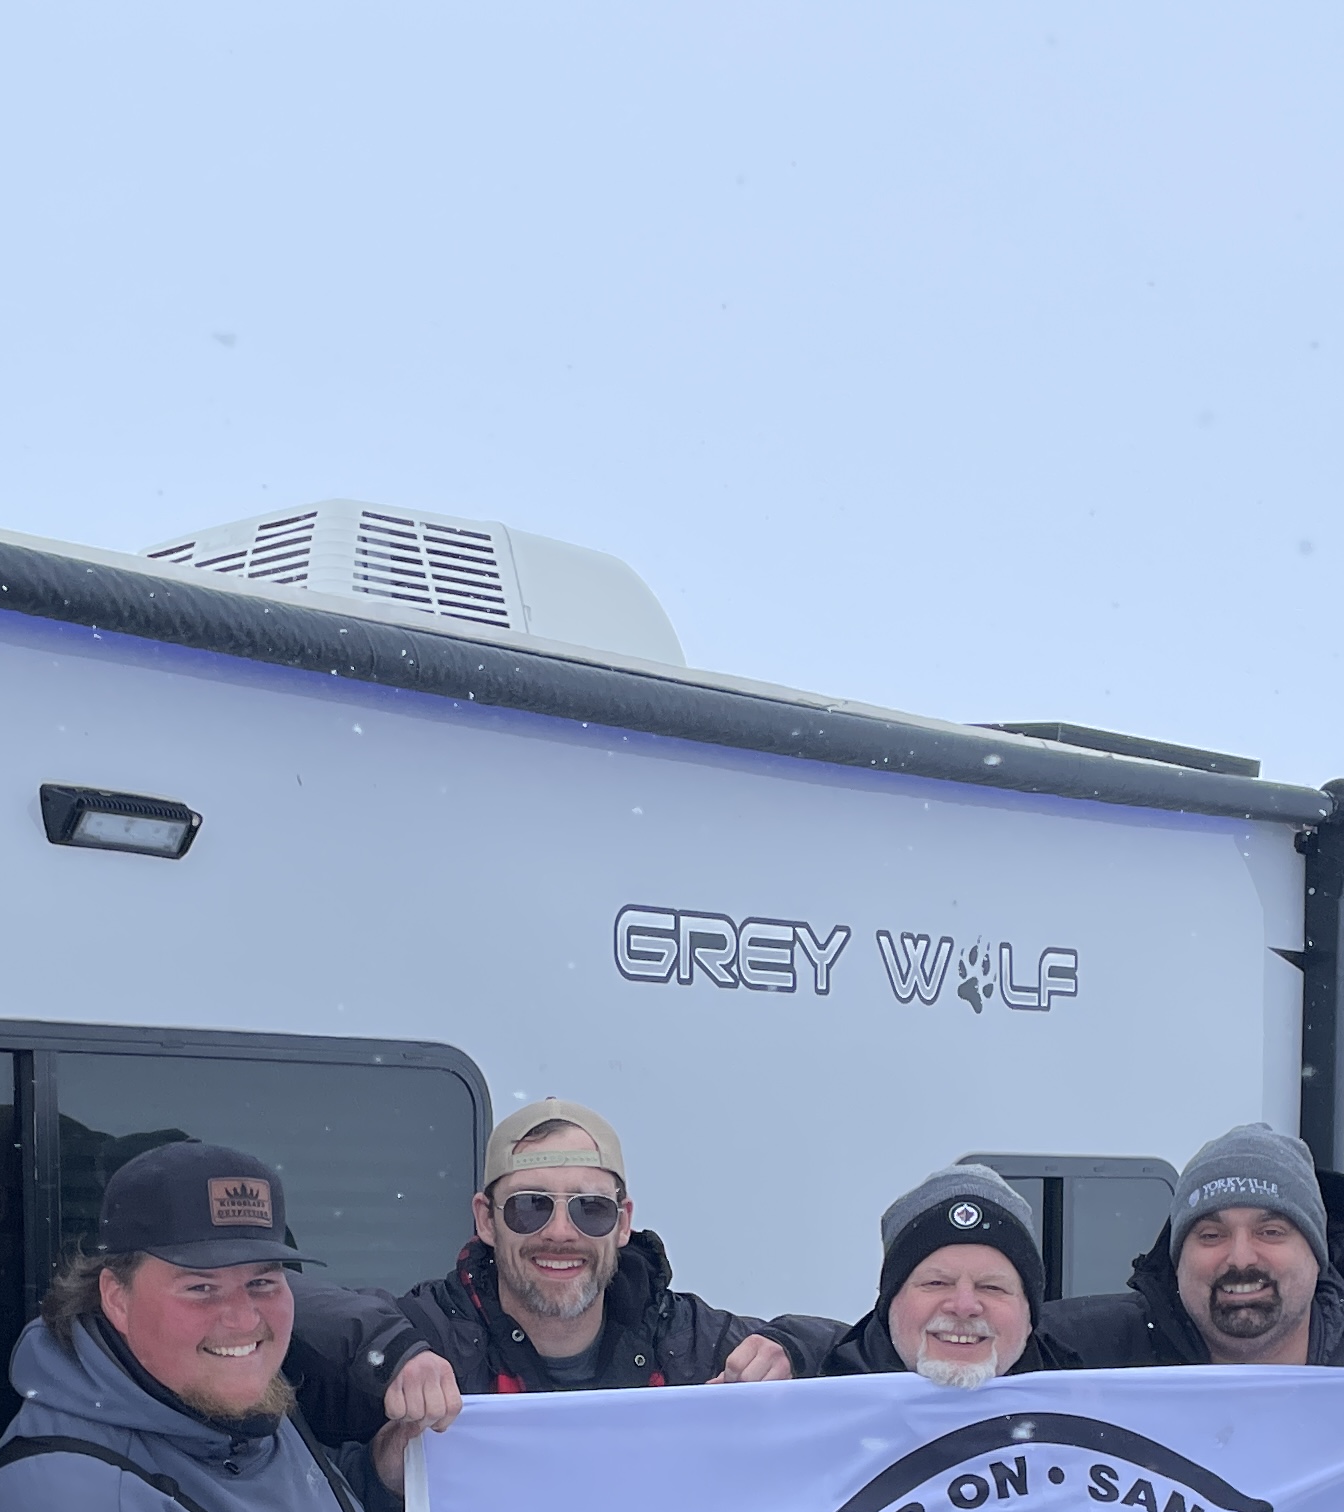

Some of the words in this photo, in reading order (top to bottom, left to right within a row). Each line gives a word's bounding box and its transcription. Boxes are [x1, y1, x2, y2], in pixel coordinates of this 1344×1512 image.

[614, 903, 851, 996] GREY
[1202, 1176, 1279, 1194] YORKVILLE
[947, 1456, 1029, 1509] ON
